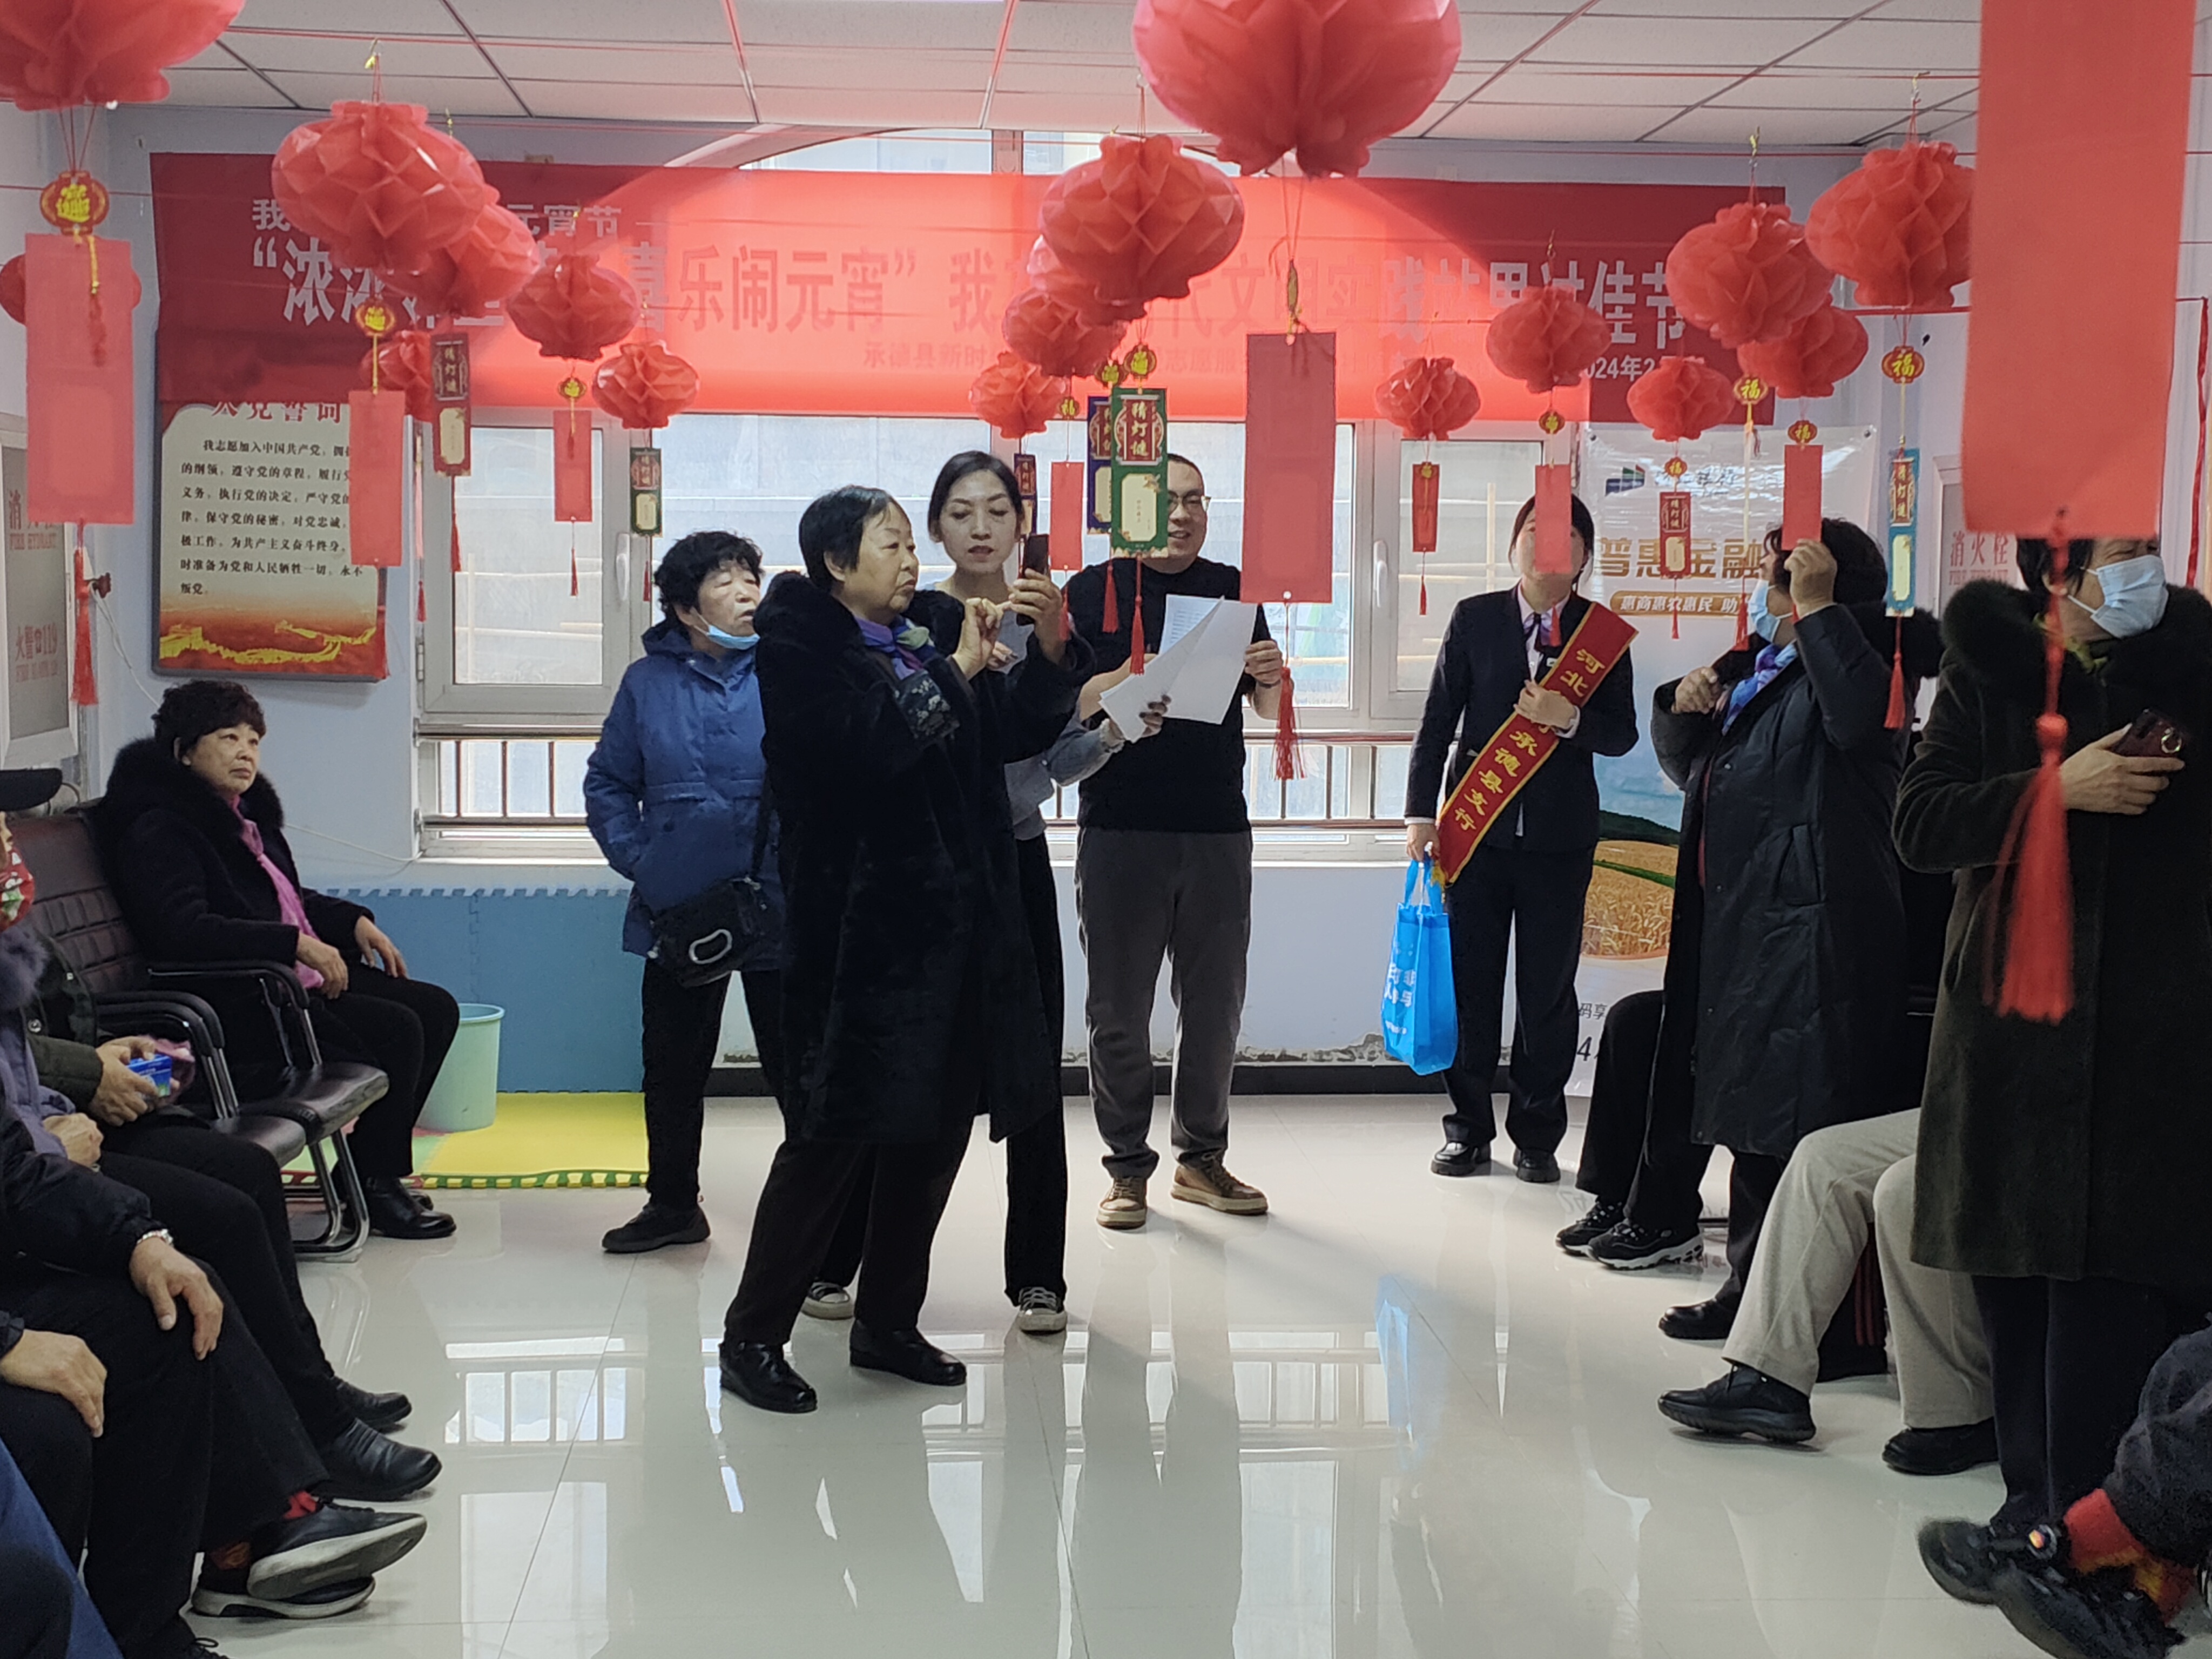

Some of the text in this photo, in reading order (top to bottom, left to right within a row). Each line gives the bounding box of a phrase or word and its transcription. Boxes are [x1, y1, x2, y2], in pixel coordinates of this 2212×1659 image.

[1892, 353, 1914, 376] 福
[1741, 378, 1761, 399] 福
[1796, 424, 1811, 440] 福
[1621, 595, 1713, 613] 惠商惠农惠民
[1454, 649, 1605, 831] 河北承德县支行
